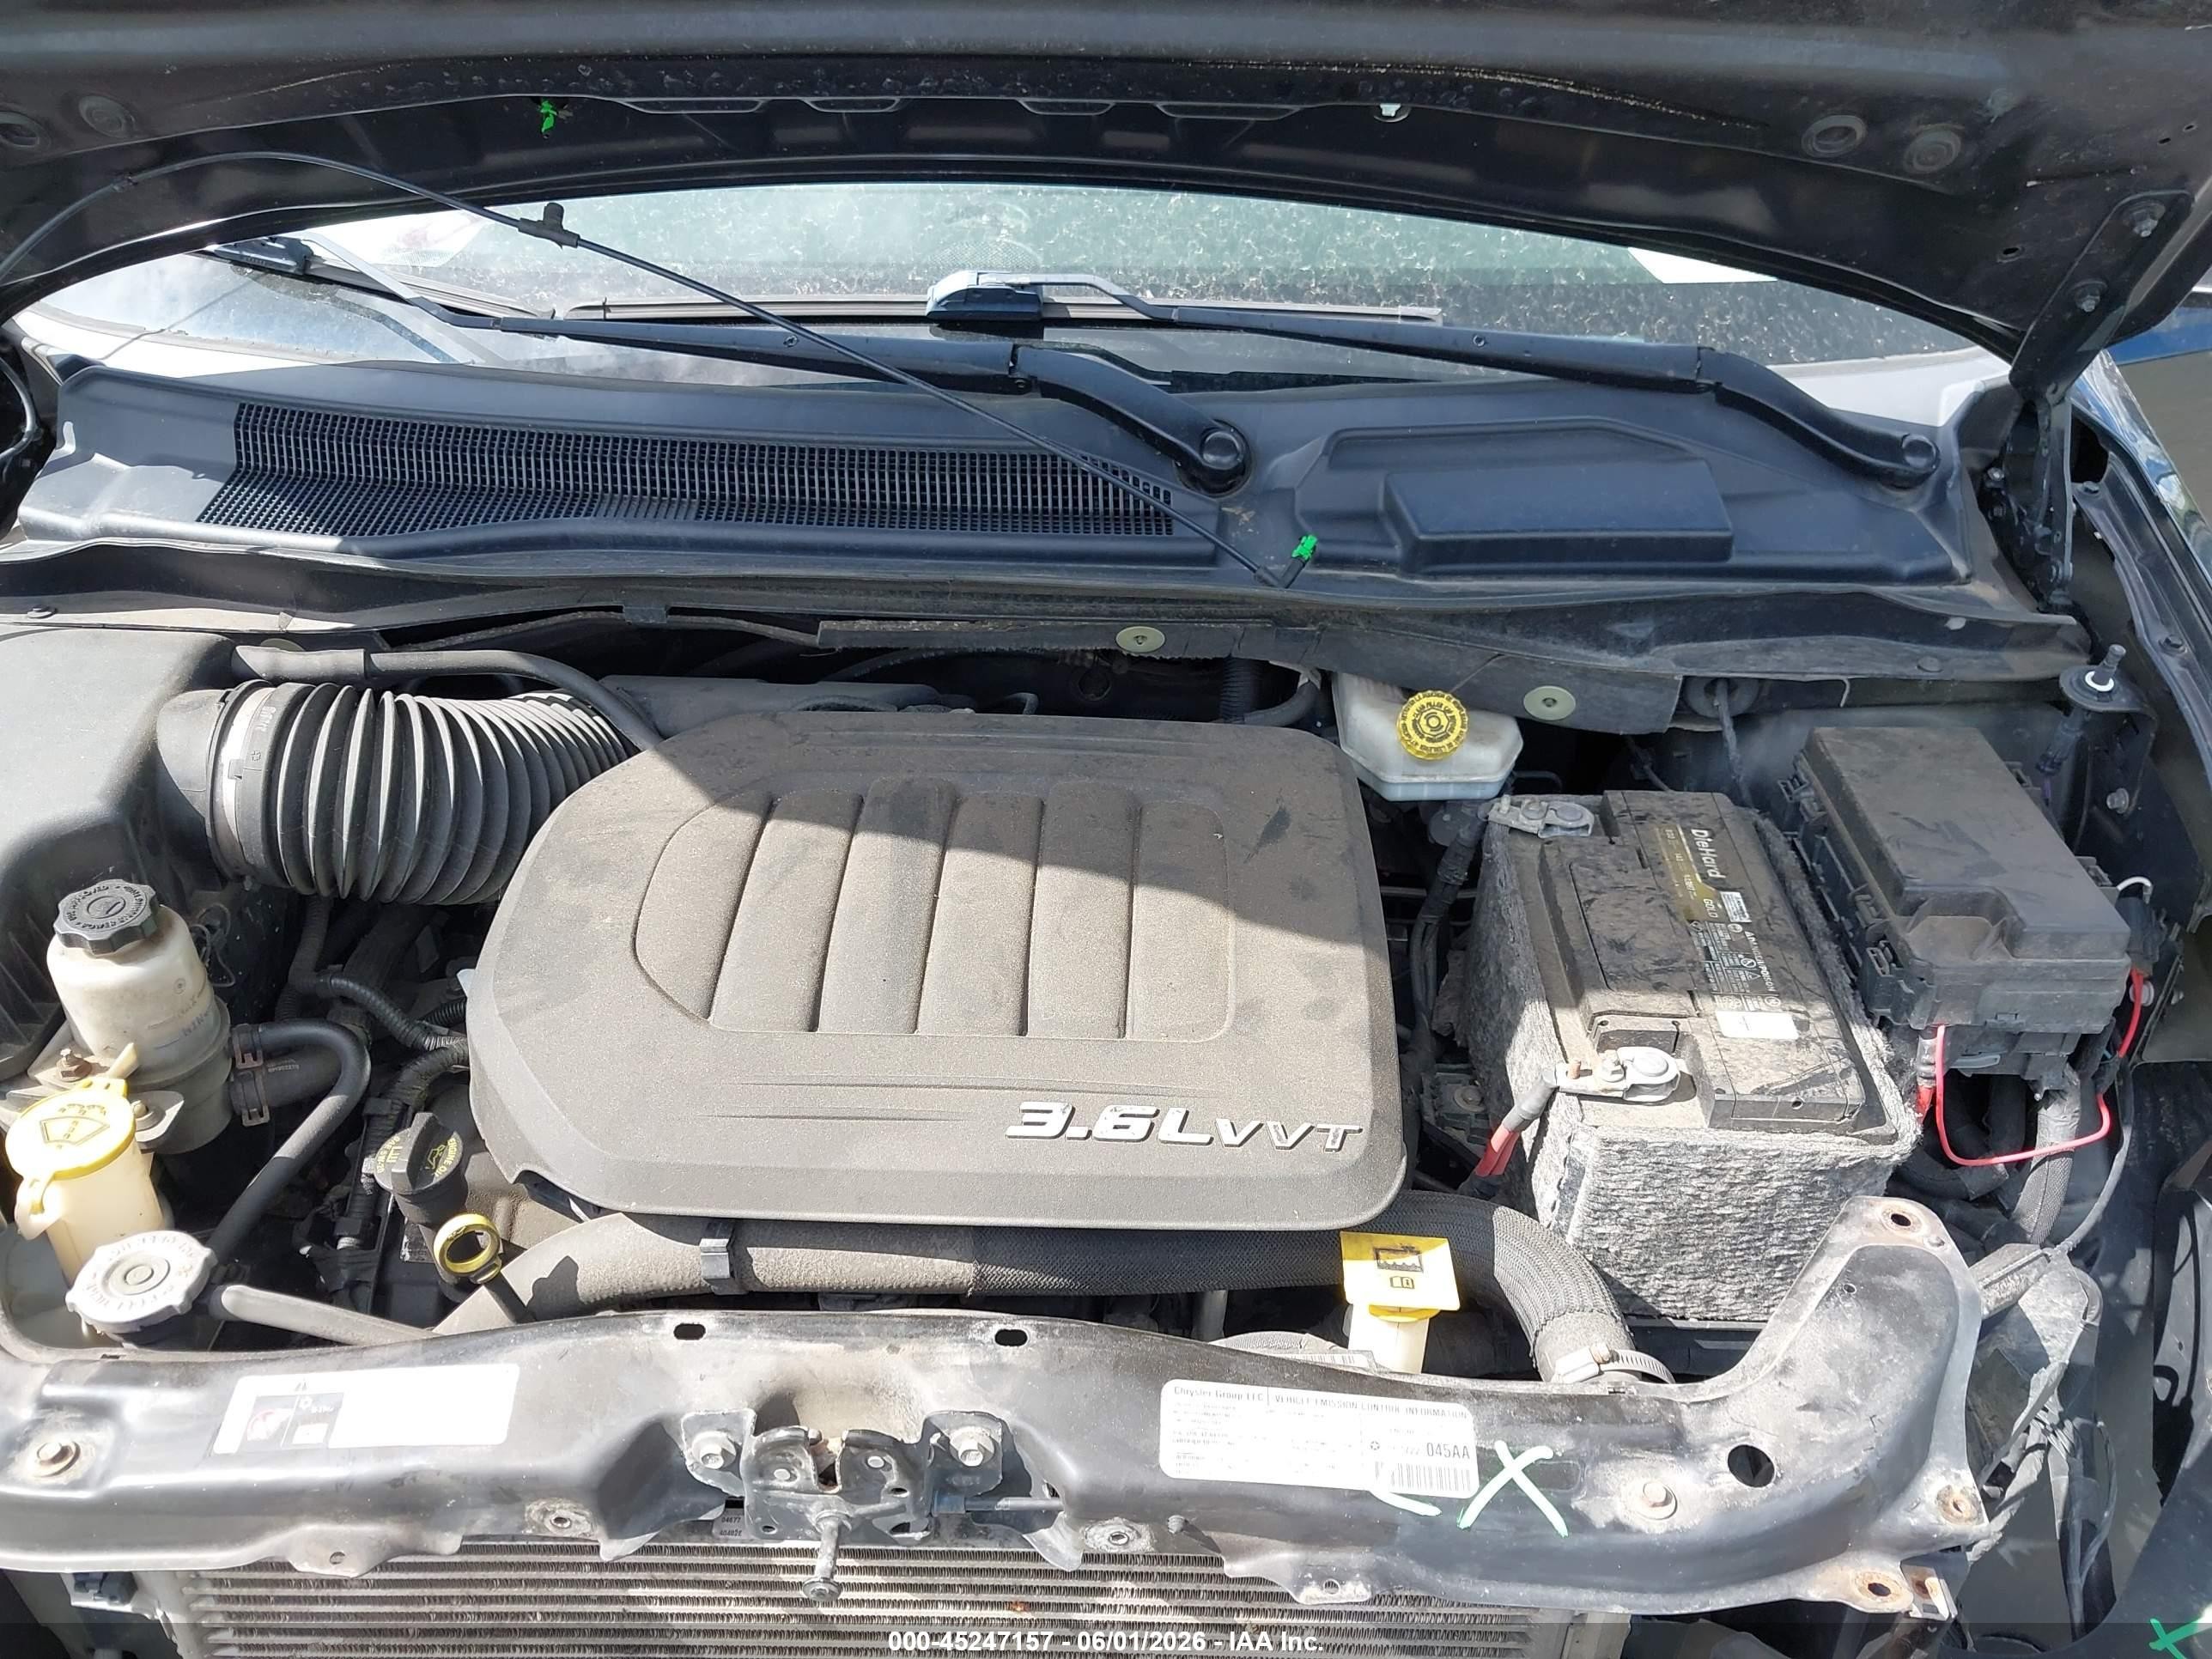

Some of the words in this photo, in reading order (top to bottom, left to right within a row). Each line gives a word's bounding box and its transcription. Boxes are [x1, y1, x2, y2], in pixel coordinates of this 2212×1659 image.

[1691, 828, 1727, 879] DieHard
[1703, 898, 1718, 919] GOLD
[1215, 1118, 1364, 1153] VVT
[443, 1138, 458, 1165] ENGINE
[434, 1165, 447, 1177] OIL
[1215, 1389, 1243, 1401] Group
[1315, 1397, 1358, 1411] EMISSION
[1426, 1441, 1470, 1460] 045AA
